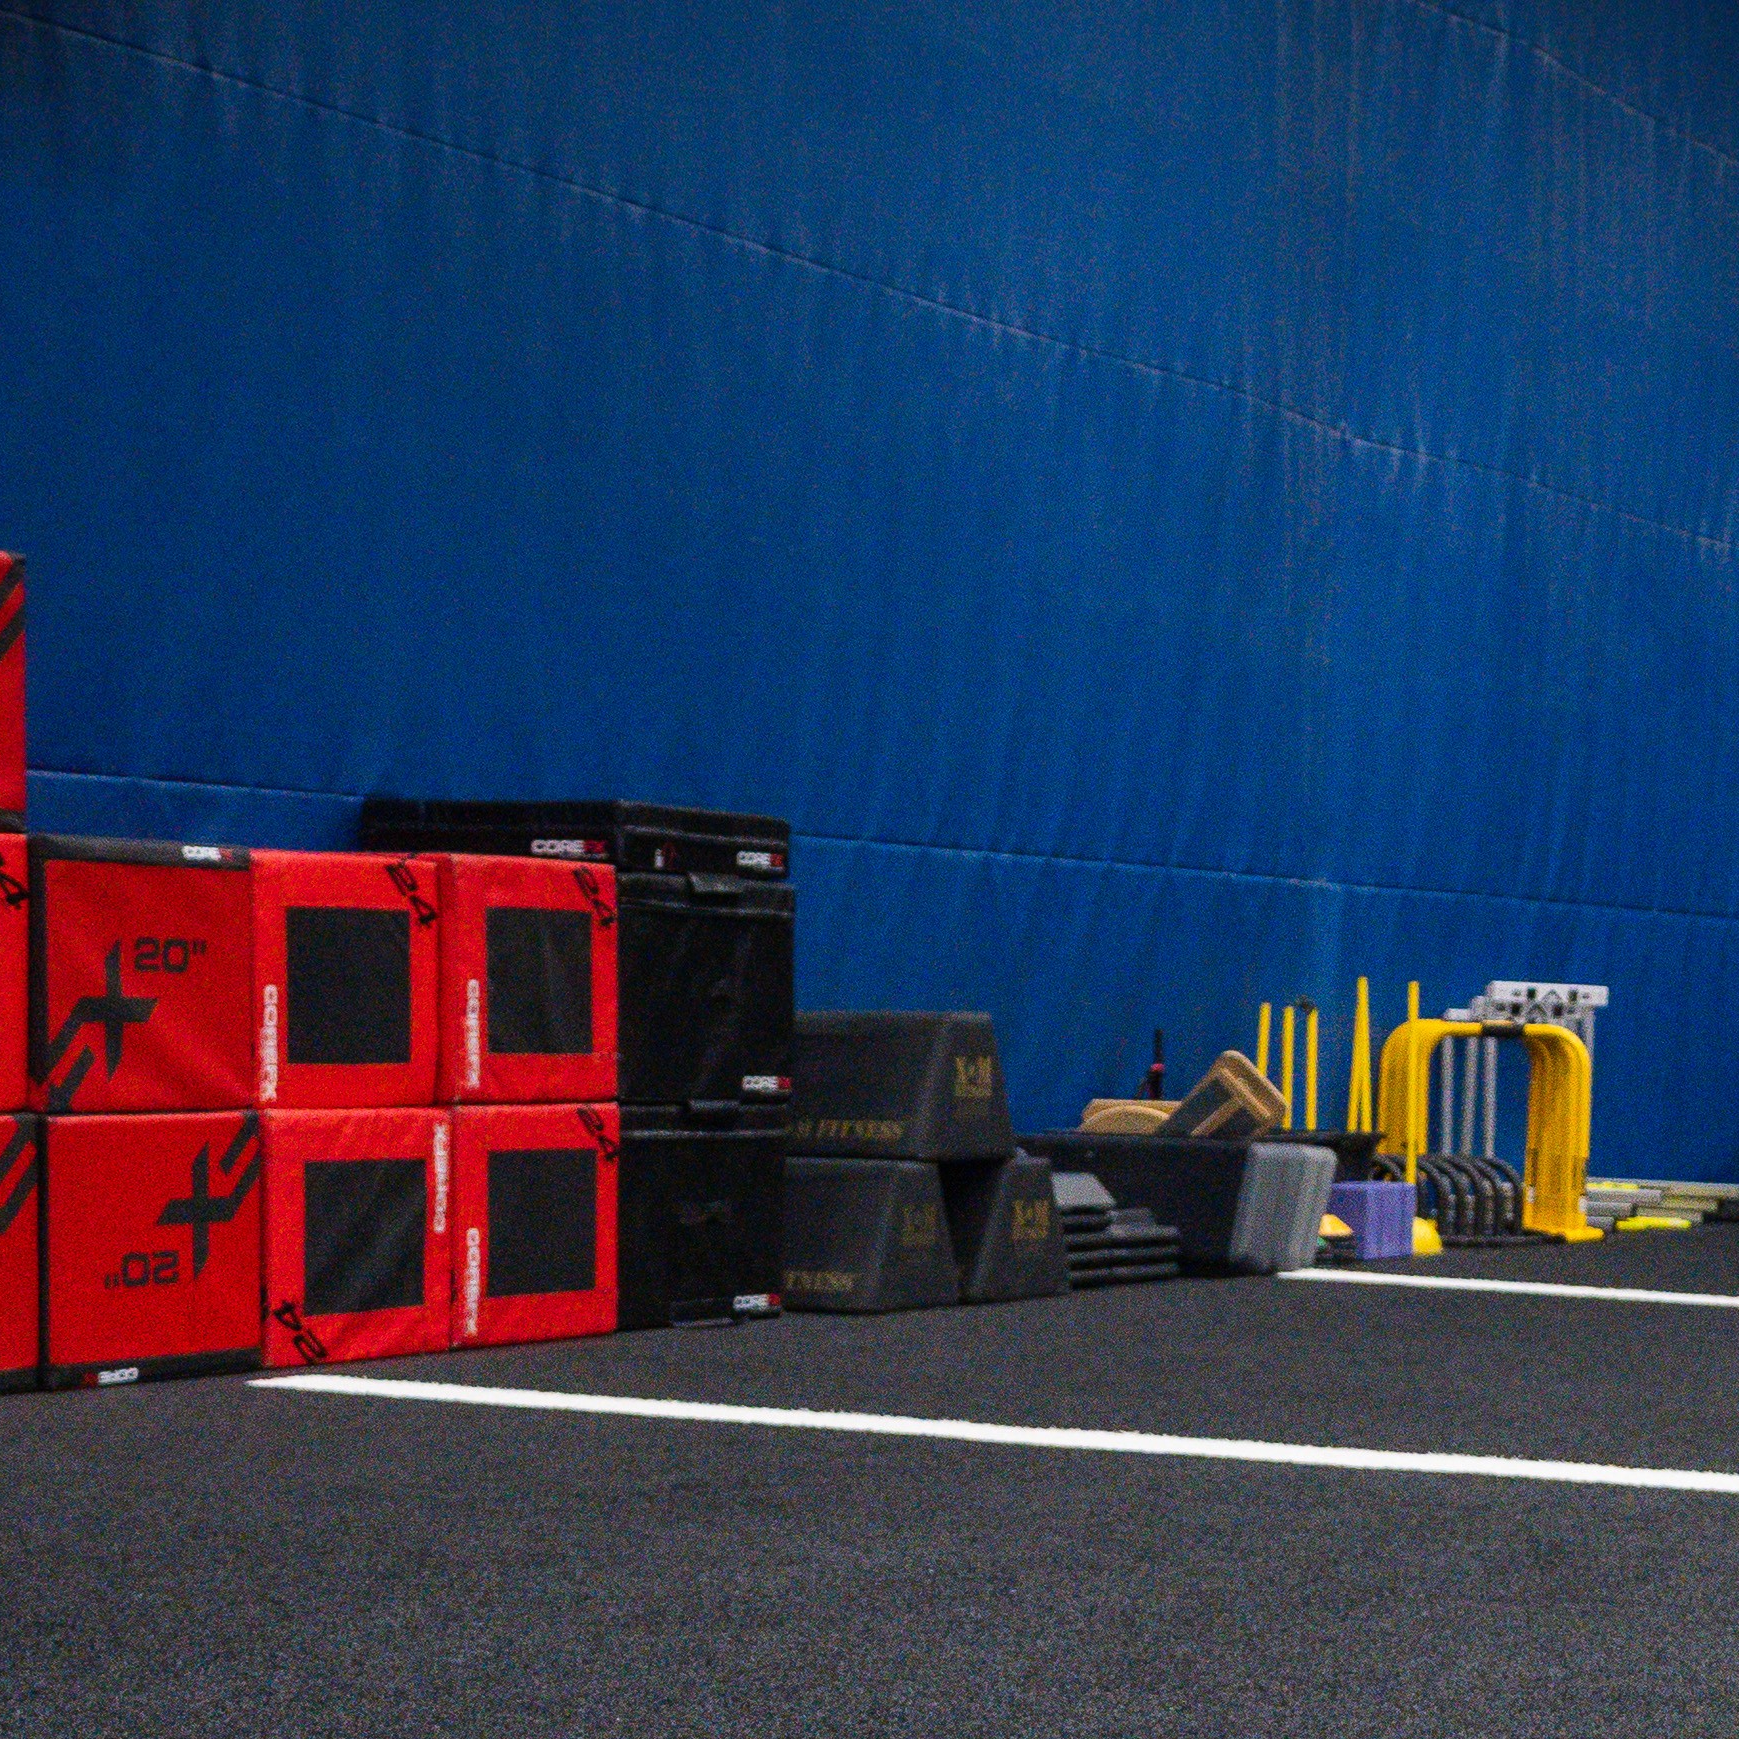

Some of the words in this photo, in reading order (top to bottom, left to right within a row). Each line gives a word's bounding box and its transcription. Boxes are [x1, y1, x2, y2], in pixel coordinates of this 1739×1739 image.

[530, 838, 607, 856] COREFX
[134, 937, 207, 972] 20"
[262, 984, 278, 1102] COREFX
[105, 1250, 180, 1290] 20"
